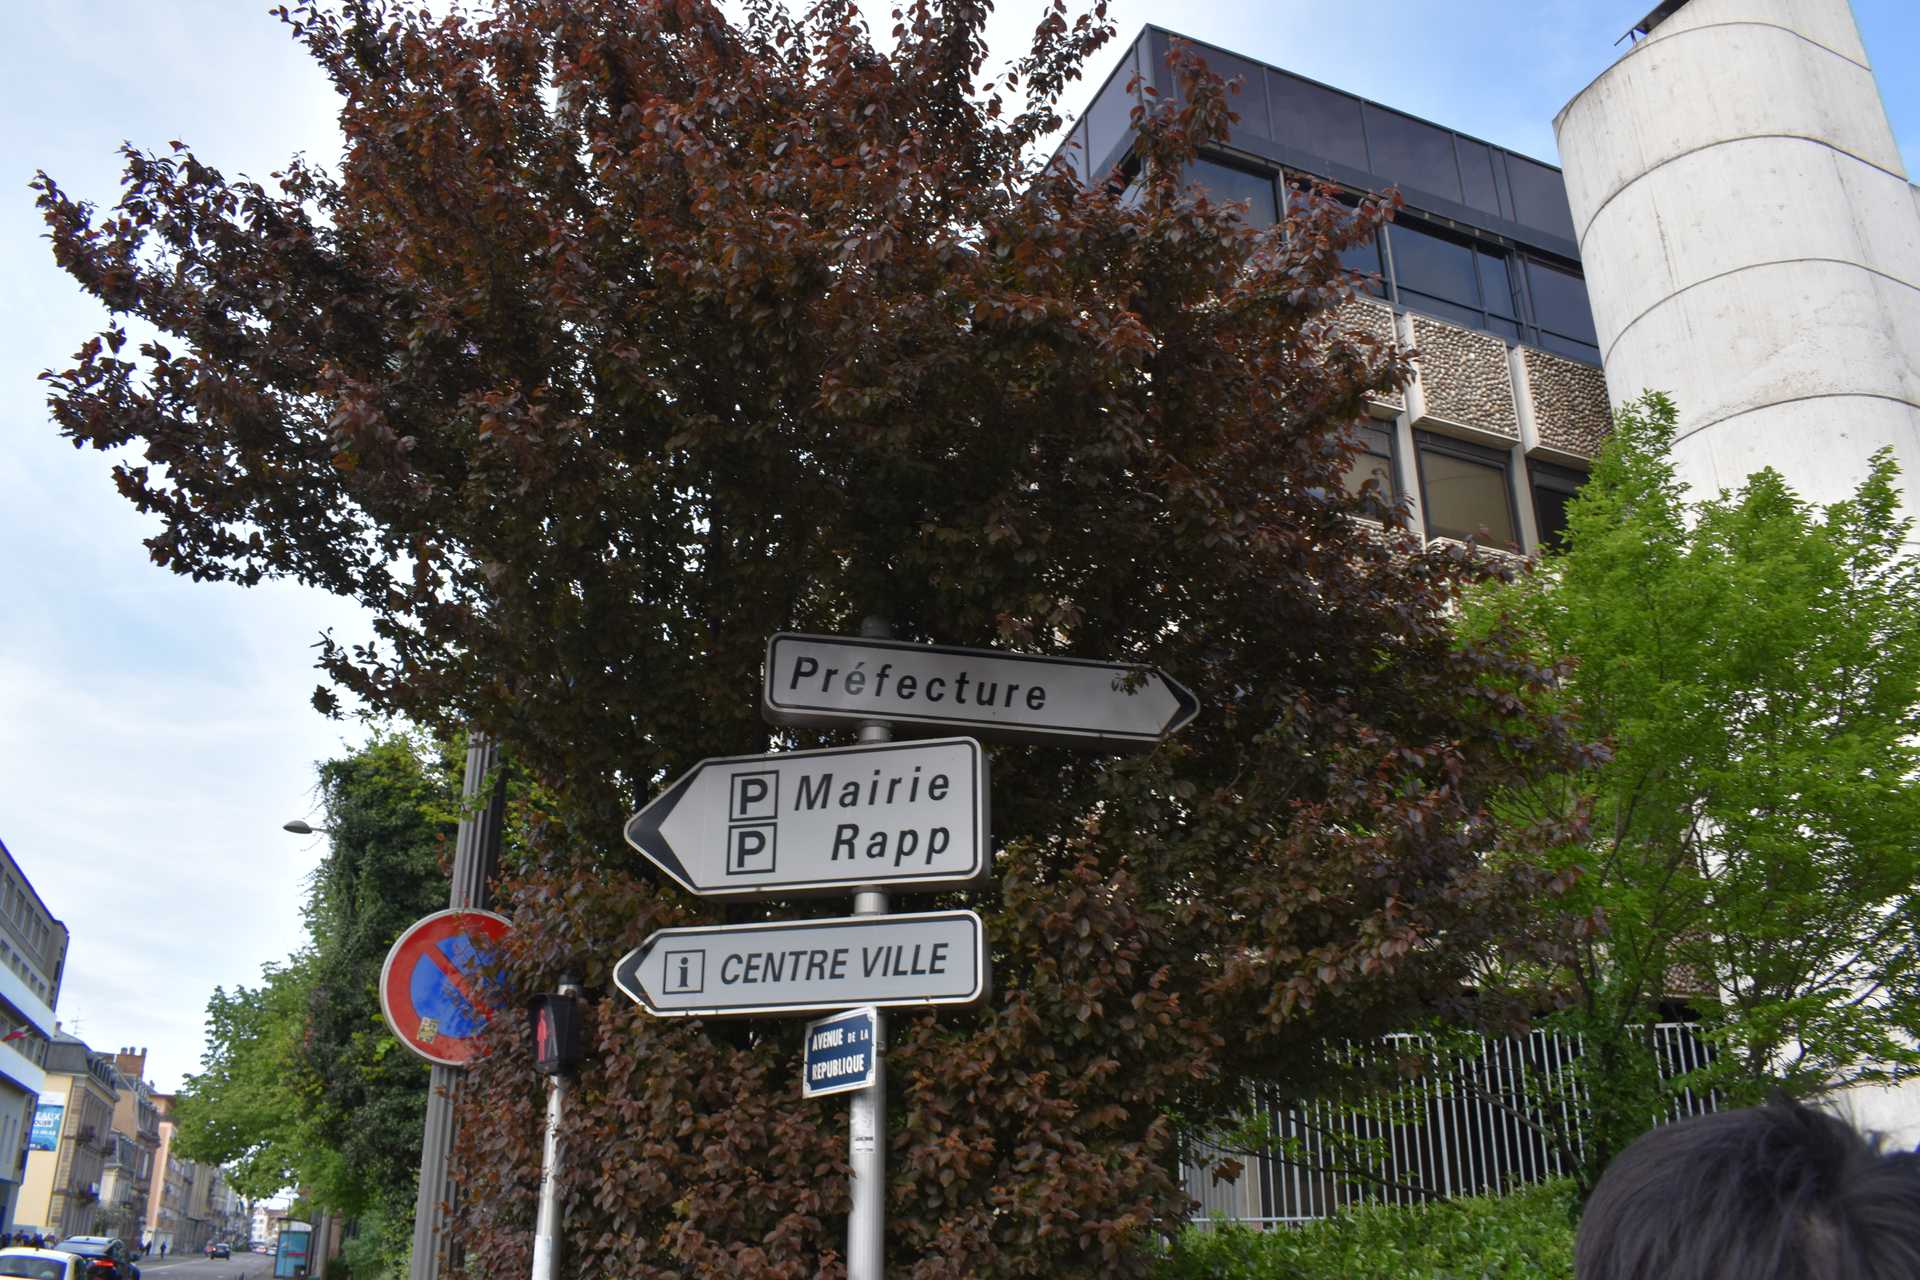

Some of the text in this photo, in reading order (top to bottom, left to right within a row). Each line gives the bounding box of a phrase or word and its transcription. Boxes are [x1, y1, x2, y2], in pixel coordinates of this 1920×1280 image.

[791, 656, 1046, 711] Préfecture
[740, 766, 950, 816] P Mairie
[737, 824, 950, 869] P Rapp
[720, 948, 849, 986] CENTRE
[862, 943, 949, 978] VILLE
[812, 1028, 869, 1051] AVENUE DE LA
